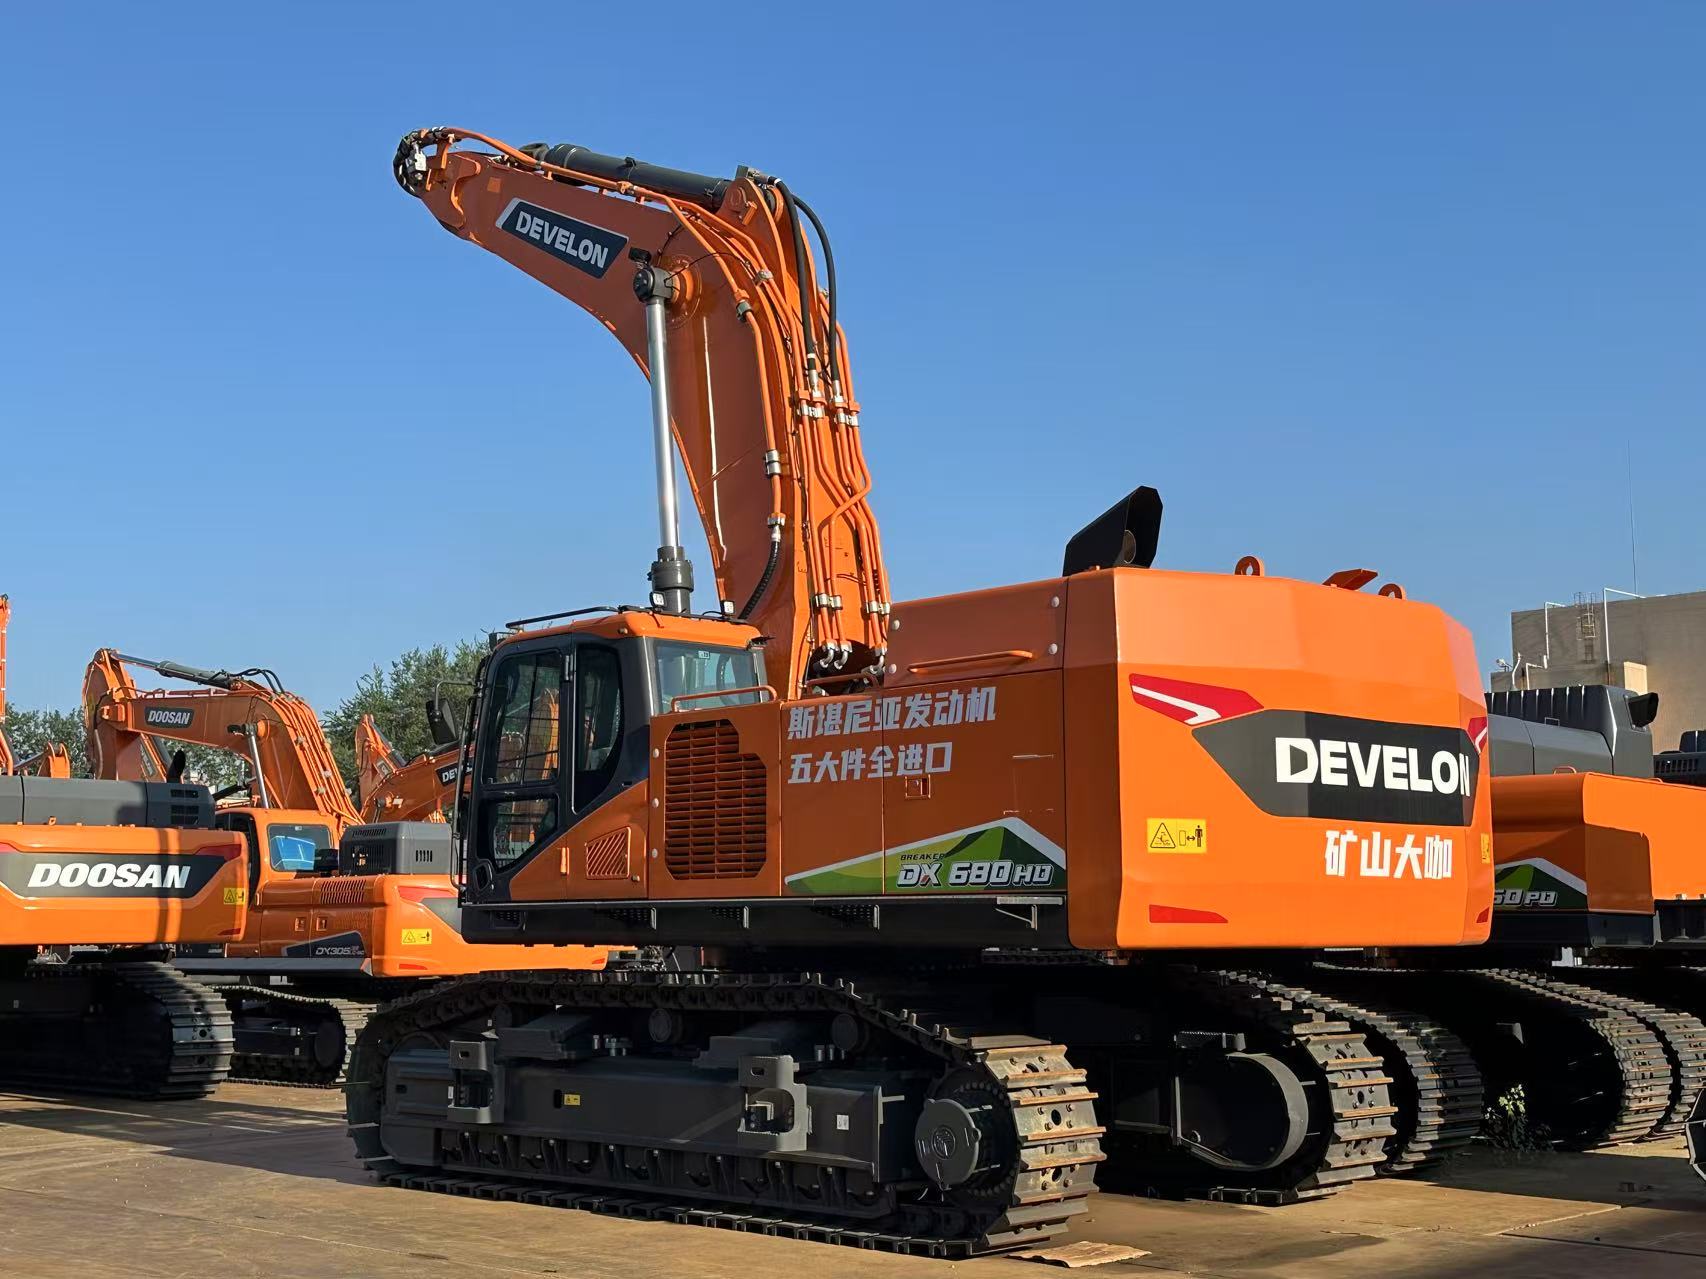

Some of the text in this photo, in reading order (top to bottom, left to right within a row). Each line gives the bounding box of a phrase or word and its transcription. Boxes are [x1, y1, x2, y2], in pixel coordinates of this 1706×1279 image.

[515, 210, 609, 269] DEVELON
[147, 710, 190, 724] DOOSAN
[787, 686, 997, 740] 斯堪尼亚发动机
[787, 741, 953, 784] 五大件全进口
[1275, 737, 1471, 797] DEVELON
[27, 862, 191, 889] DOOSAN
[897, 862, 943, 888] DX
[1324, 829, 1453, 880] 矿山大咖
